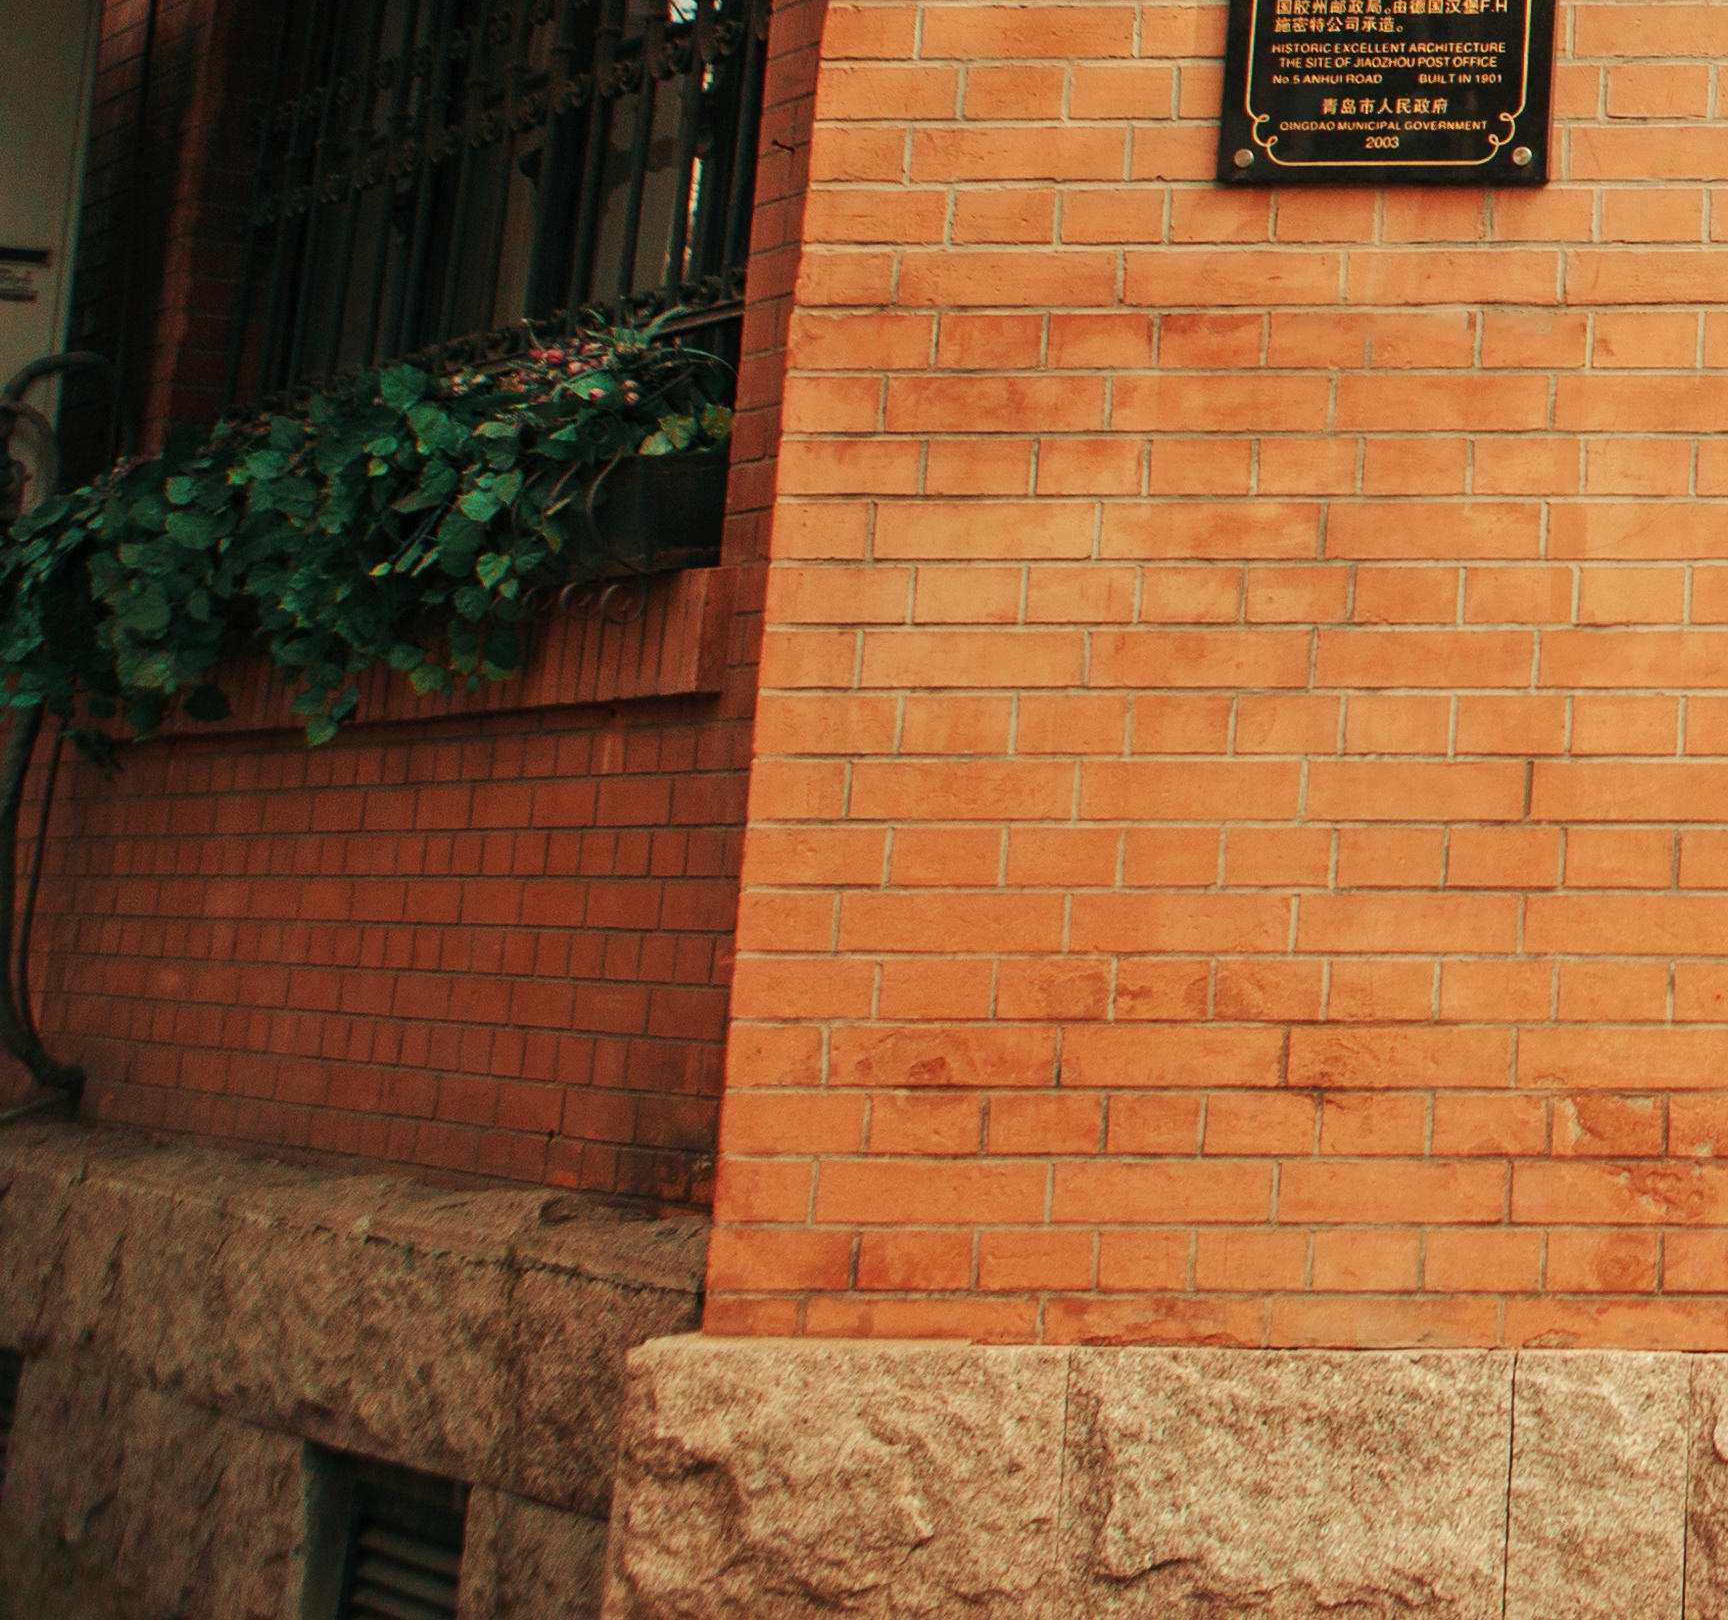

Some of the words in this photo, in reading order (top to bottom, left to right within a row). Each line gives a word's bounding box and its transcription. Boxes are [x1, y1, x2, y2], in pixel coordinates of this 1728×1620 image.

[1271, 43, 1332, 54] HISTORIC
[1334, 42, 1406, 54] EXCELLENT
[1408, 42, 1507, 54] ARCHITECTURE
[1279, 57, 1302, 68] THE
[1304, 57, 1332, 68] SITE
[1335, 57, 1351, 68] OF
[1353, 57, 1416, 68] JIAOZHOU
[1417, 57, 1450, 68] POST
[1452, 57, 1498, 68] OFFICE
[1302, 74, 1343, 84] ANHUI
[1346, 74, 1383, 84] ROAD
[1418, 73, 1457, 84] BUILT
[1458, 73, 1472, 84] IN
[1475, 73, 1503, 84] 1901
[1321, 97, 1449, 115] 青岛市人民政府
[1279, 121, 1336, 131] QINGDAO
[1337, 121, 1401, 131] MUNICIPAL
[1404, 120, 1488, 130] GOVERNMENT
[1364, 136, 1400, 149] 2003
